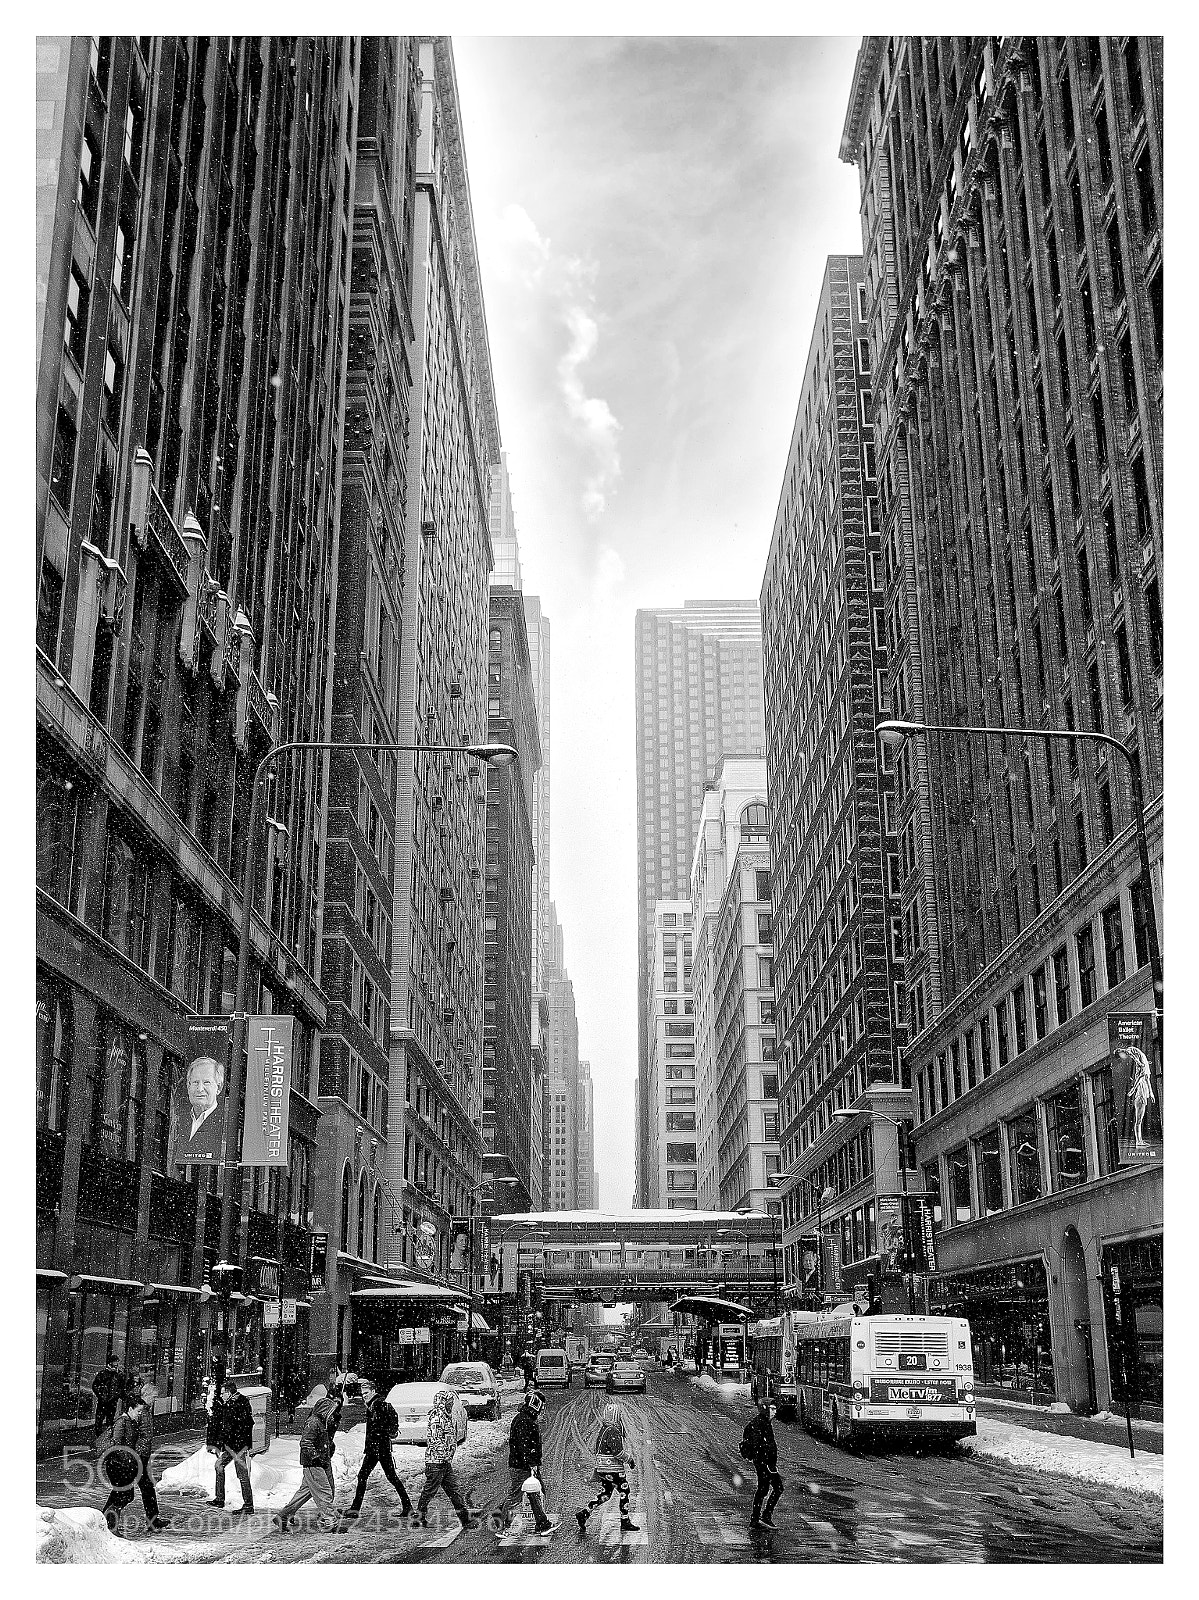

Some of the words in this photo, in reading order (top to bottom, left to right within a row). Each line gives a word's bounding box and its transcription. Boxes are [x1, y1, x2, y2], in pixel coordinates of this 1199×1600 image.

[270, 1045, 285, 1097] HARRIS
[268, 1099, 283, 1158] THEATER
[923, 1209, 933, 1238] HARRIS
[926, 1239, 936, 1271] THEATER
[906, 1356, 918, 1365] 20
[890, 1388, 926, 1399] MeTV
